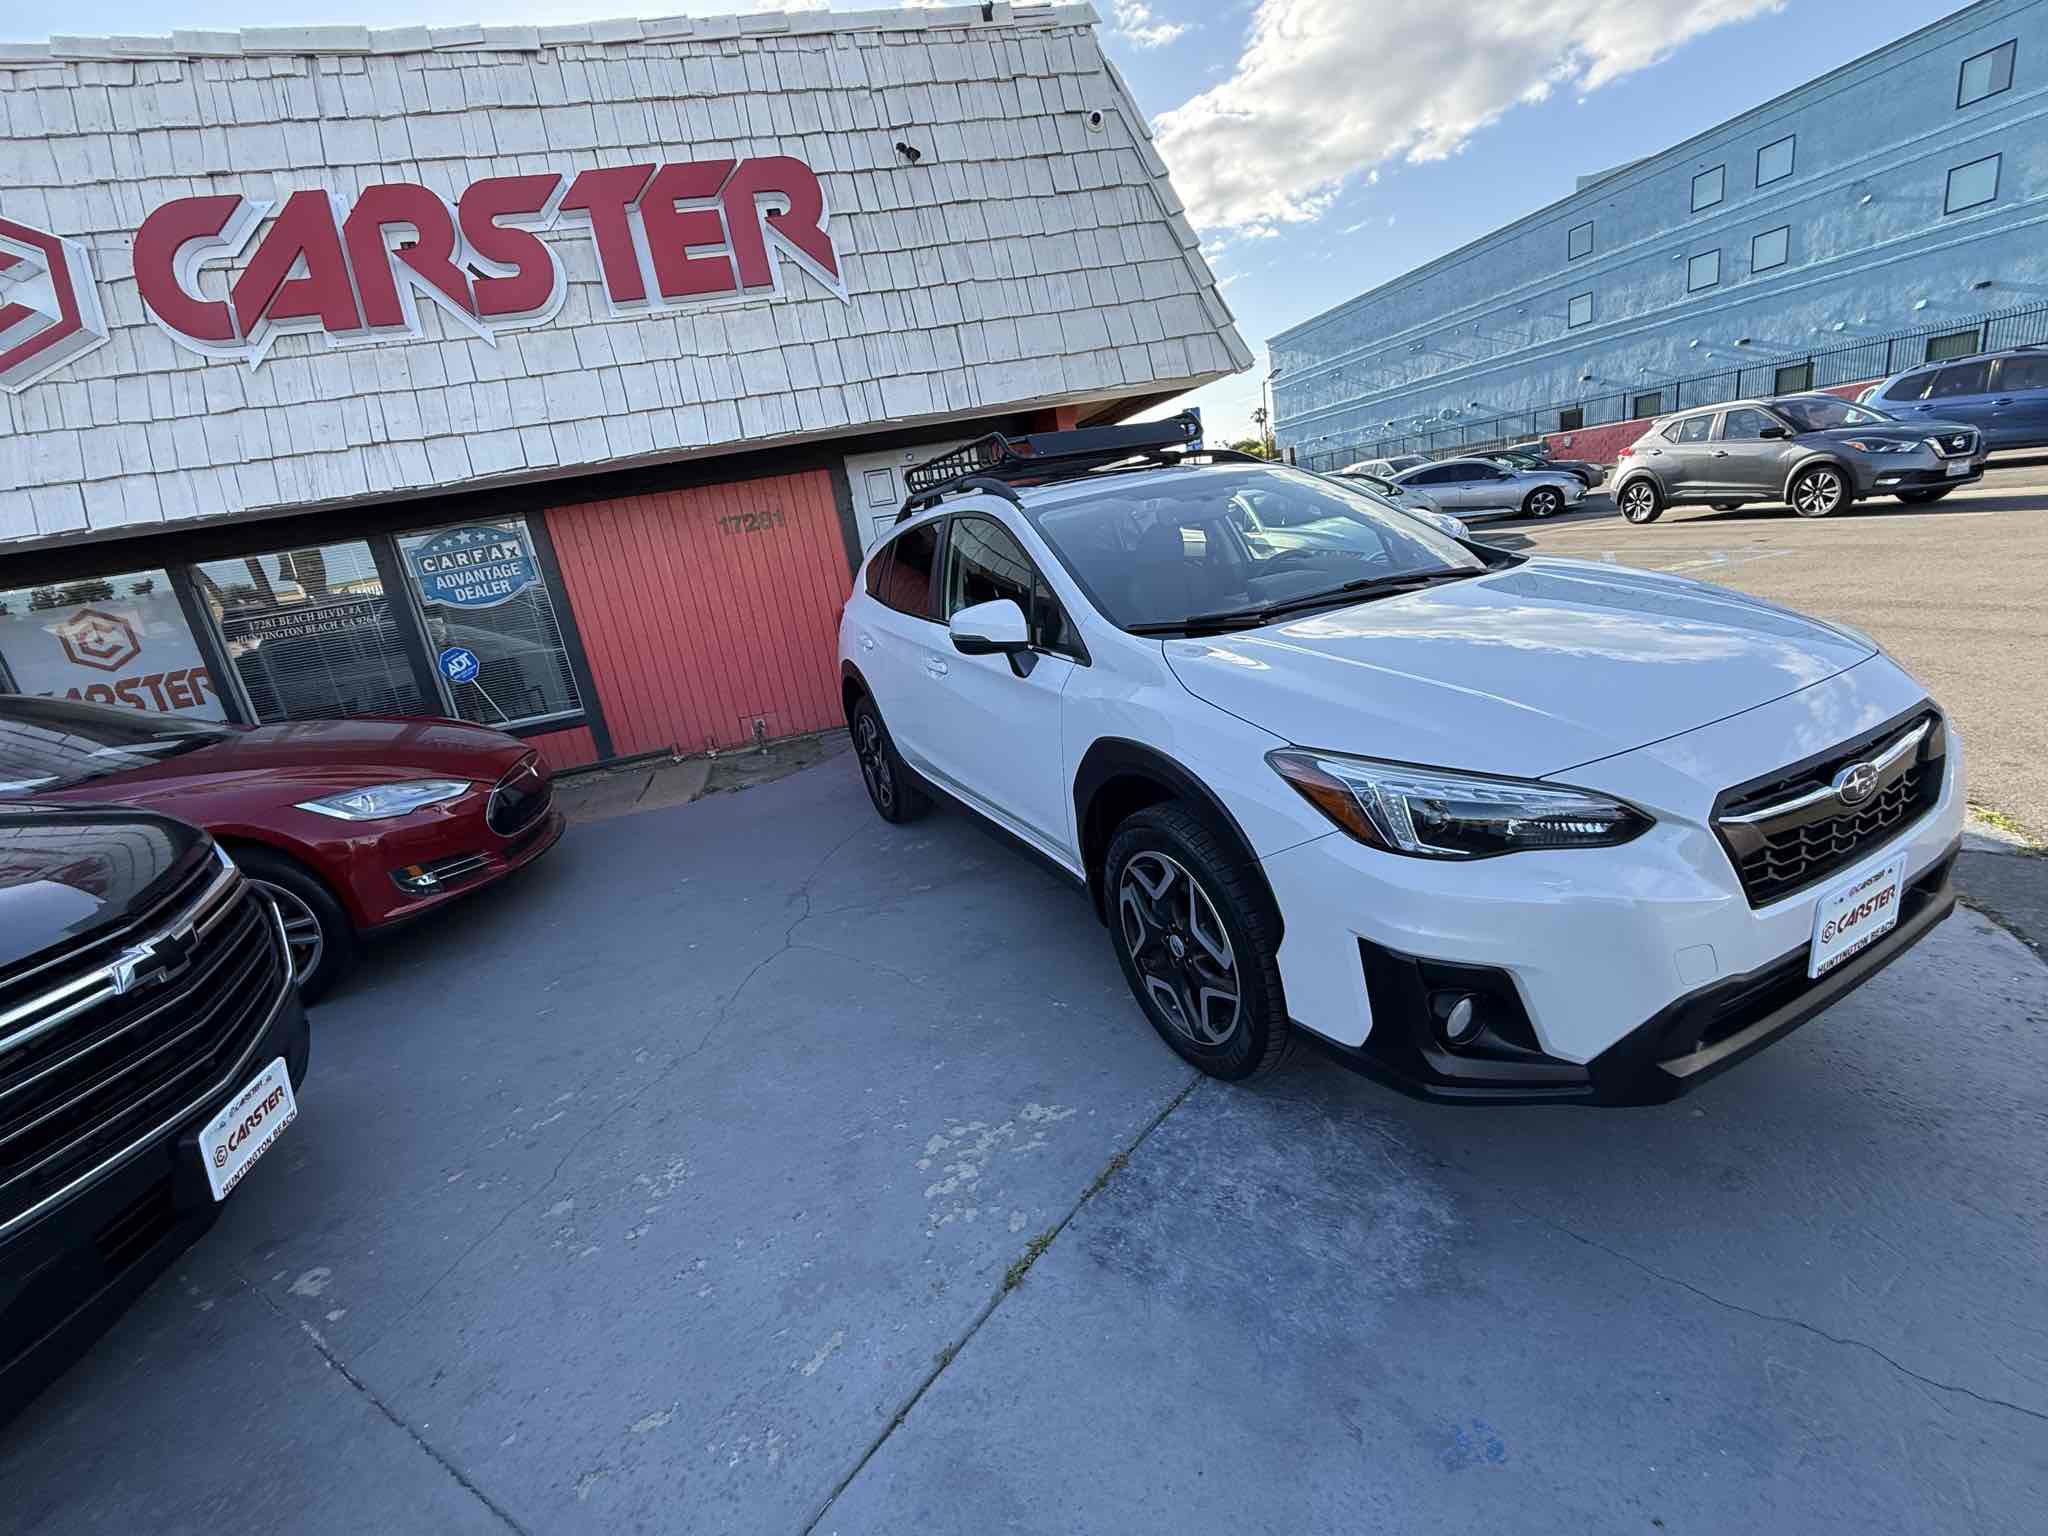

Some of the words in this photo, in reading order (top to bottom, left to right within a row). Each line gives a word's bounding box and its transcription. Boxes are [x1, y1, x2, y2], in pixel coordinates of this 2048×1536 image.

[134, 155, 842, 344] CARSTER
[421, 543, 521, 573] CARFAX
[436, 561, 521, 590] ADVANTAGE
[454, 579, 512, 601] DEALER
[235, 627, 304, 643] HUNTINGTON
[305, 620, 338, 634] BEACH
[277, 611, 315, 627] BEACH
[448, 652, 472, 677] ADT
[1837, 884, 1896, 934] CARSTER
[1817, 935, 1870, 977] HUNTINGTON
[228, 1085, 284, 1151] CARSTER
[222, 1137, 273, 1195] HUNTINGTON
[272, 1111, 297, 1137] BEACH
